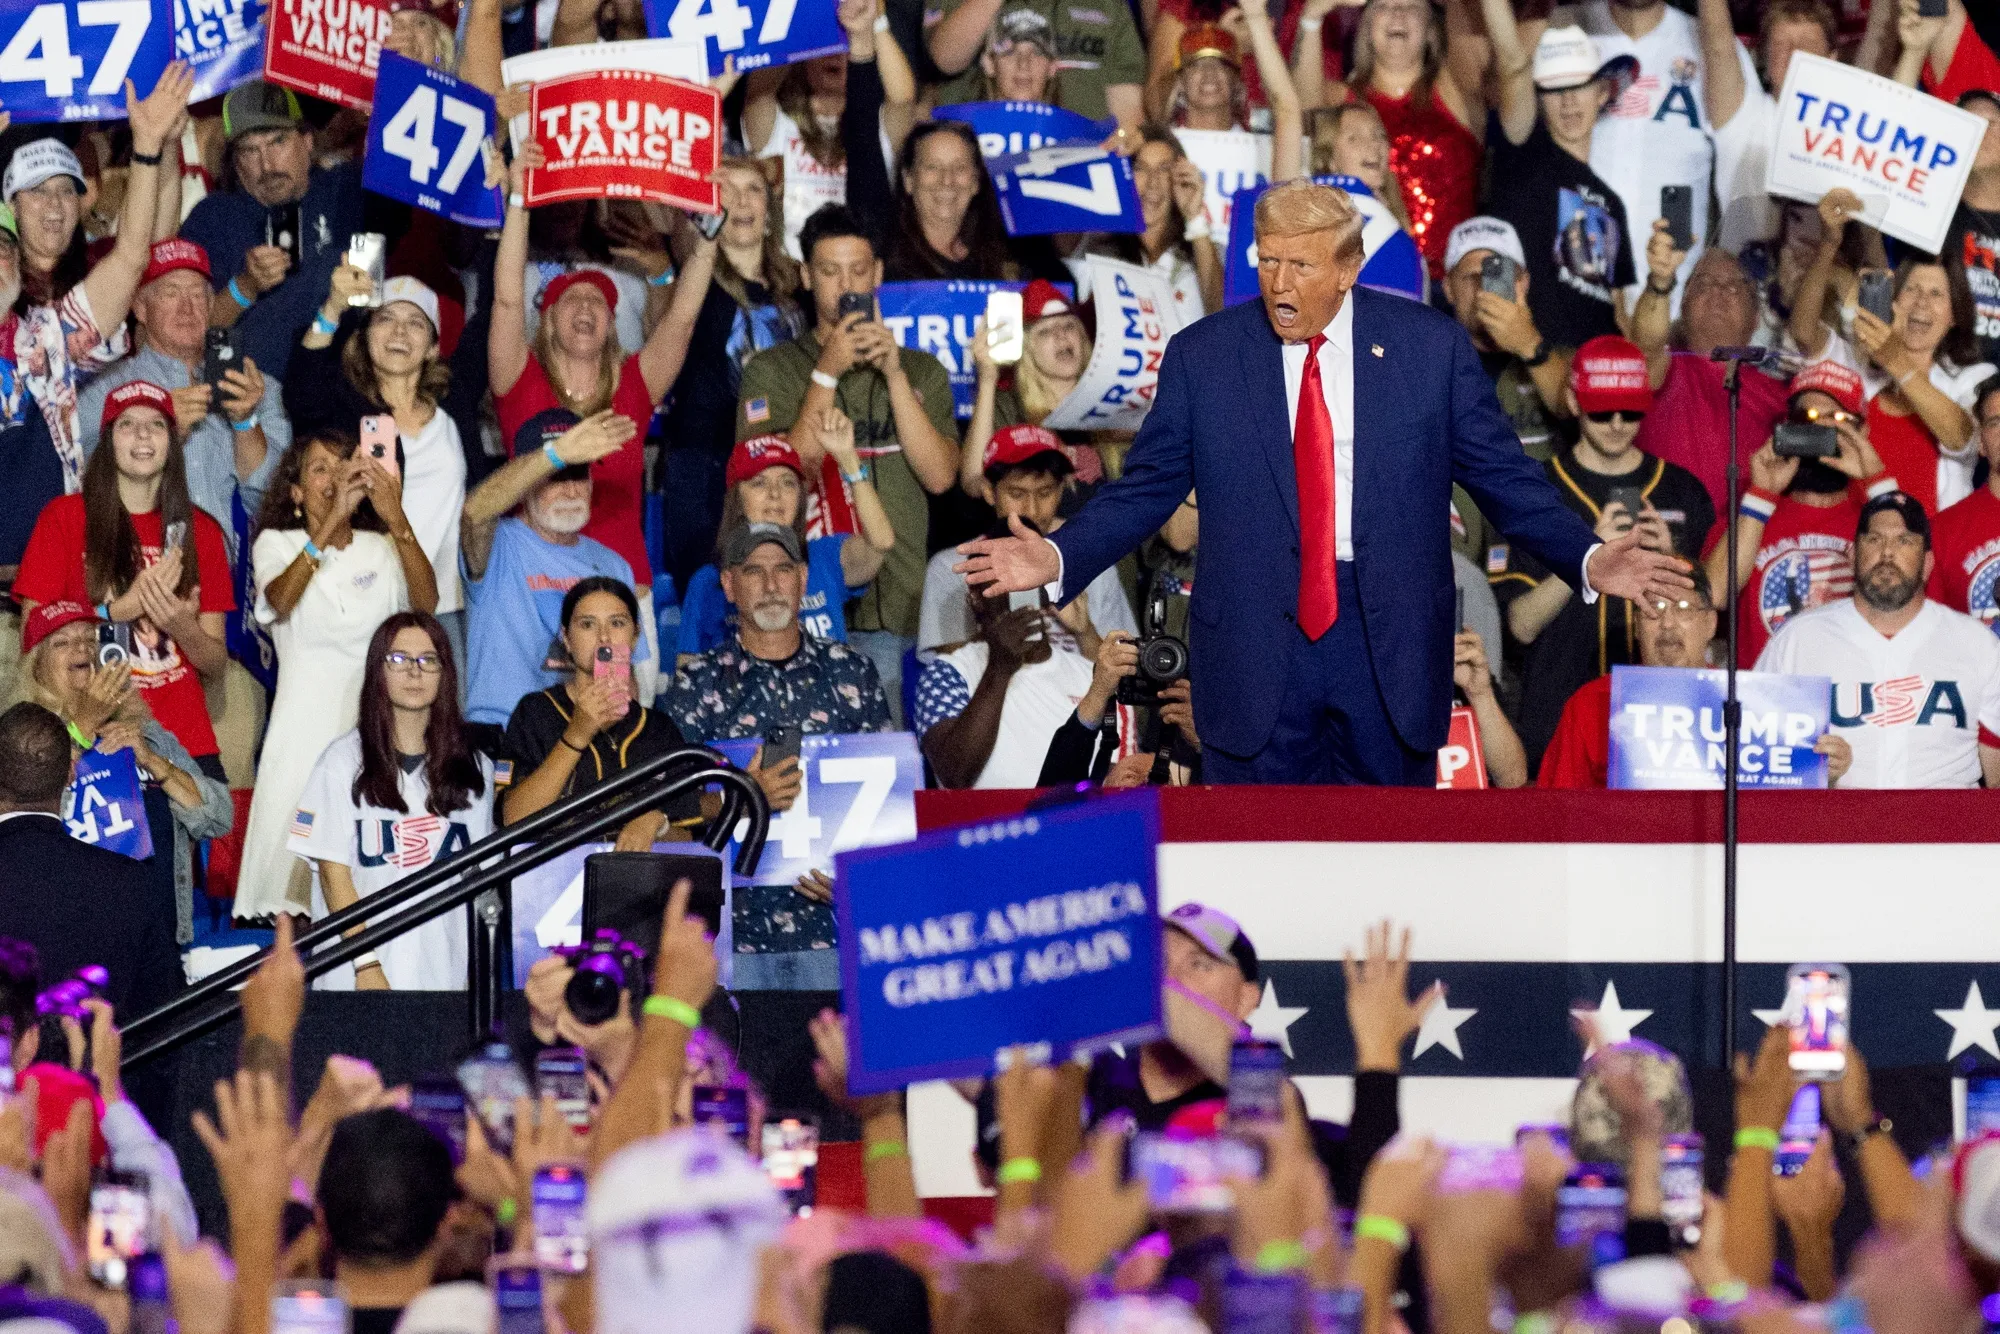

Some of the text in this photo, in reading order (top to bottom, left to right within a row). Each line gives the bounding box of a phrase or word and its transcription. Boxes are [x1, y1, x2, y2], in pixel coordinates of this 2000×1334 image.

[0, 1, 152, 97] 47
[175, 12, 249, 59] NCE
[291, 14, 380, 68] VANCE
[539, 99, 711, 144] TRUMP
[1609, 75, 1702, 129] SA
[383, 84, 486, 195] 47
[556, 131, 693, 167] VANCE
[1795, 90, 1958, 170] TRUMP
[577, 155, 627, 168] AMERICA
[1804, 128, 1930, 194] VANCE
[606, 183, 643, 197] 2024
[884, 314, 977, 349] TRU
[1079, 272, 1137, 421] TRUMP
[1624, 703, 1816, 746] TRUMP
[1831, 674, 1967, 729] USA
[1723, 774, 1759, 784] EAT
[1762, 775, 1803, 787] AGAIN!
[355, 814, 471, 868] USA
[859, 880, 1147, 966] MAKE AMERICA
[882, 929, 1132, 1008] GREAT AGAIN
